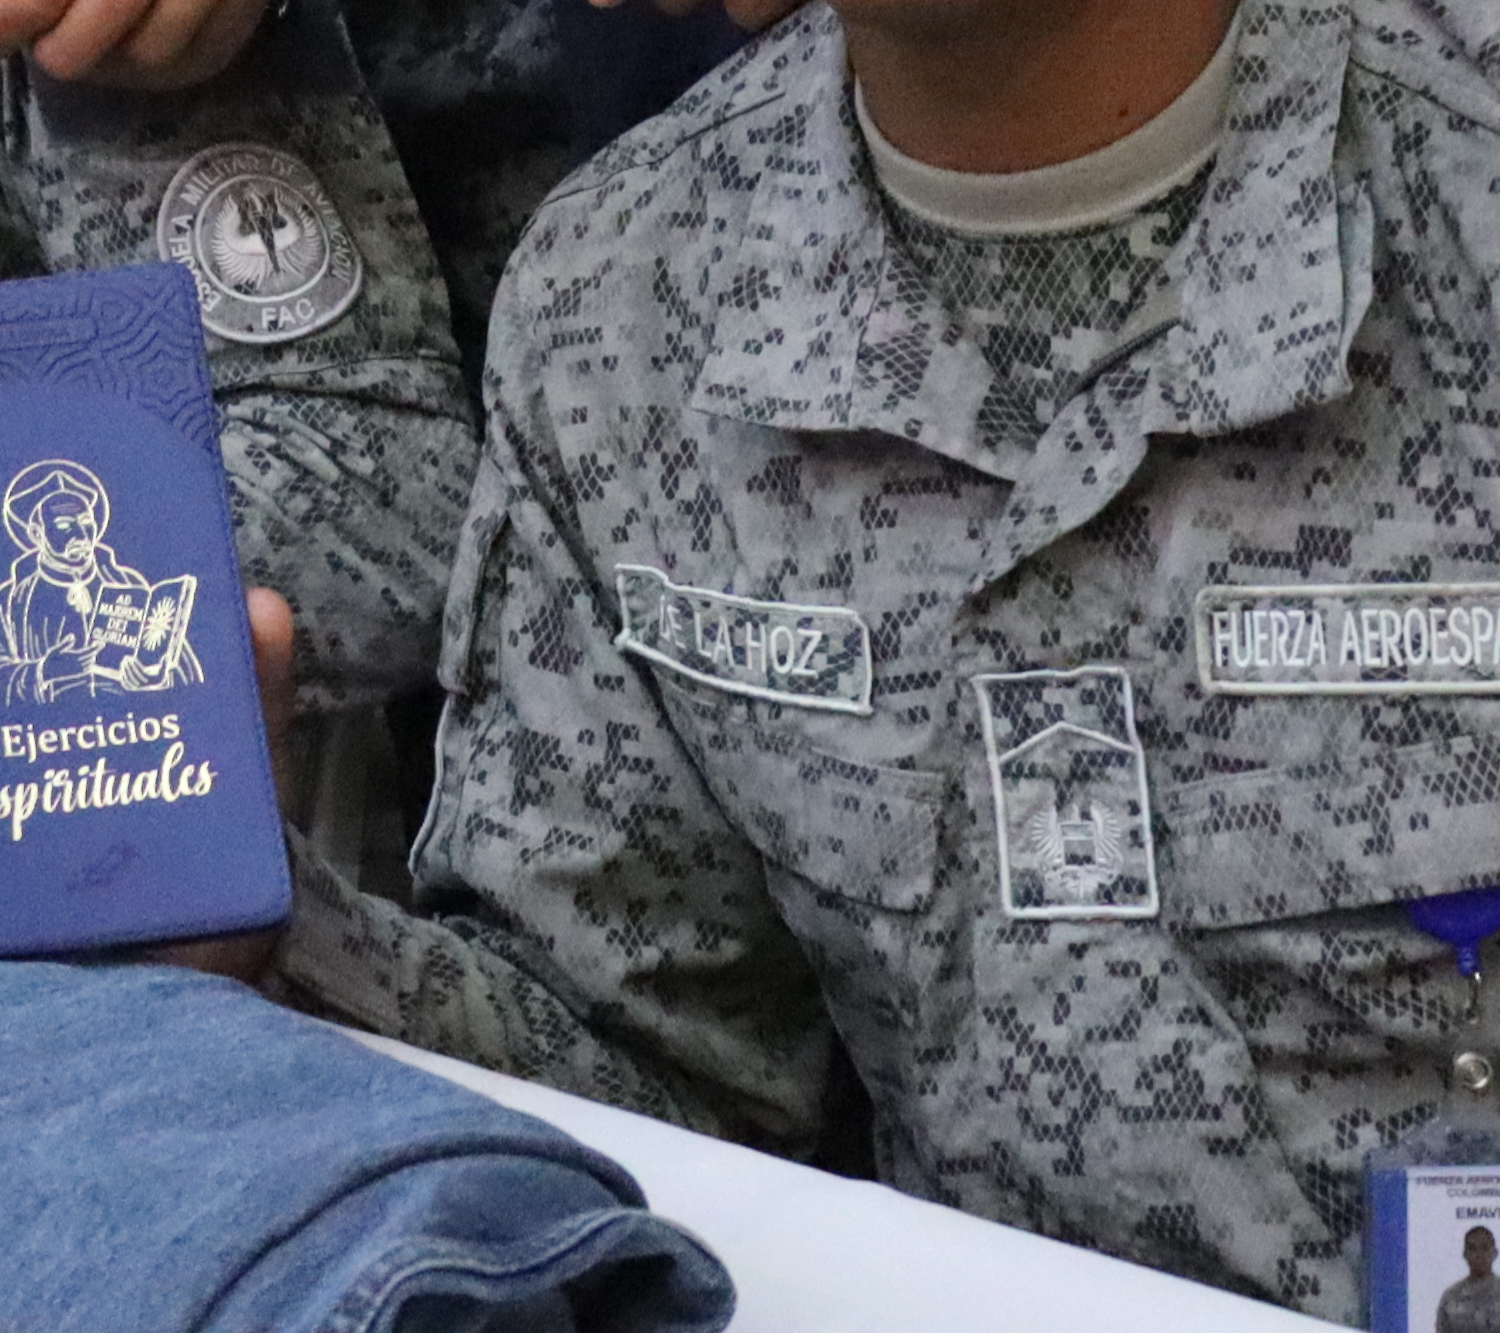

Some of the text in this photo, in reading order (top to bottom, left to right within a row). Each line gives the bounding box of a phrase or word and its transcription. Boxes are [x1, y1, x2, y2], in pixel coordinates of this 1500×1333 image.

[261, 298, 316, 330] FAC
[693, 610, 736, 668] LA
[745, 620, 823, 680] HOZ
[1211, 608, 1327, 668] FUERZA
[1, 712, 181, 763] Ejercicios
